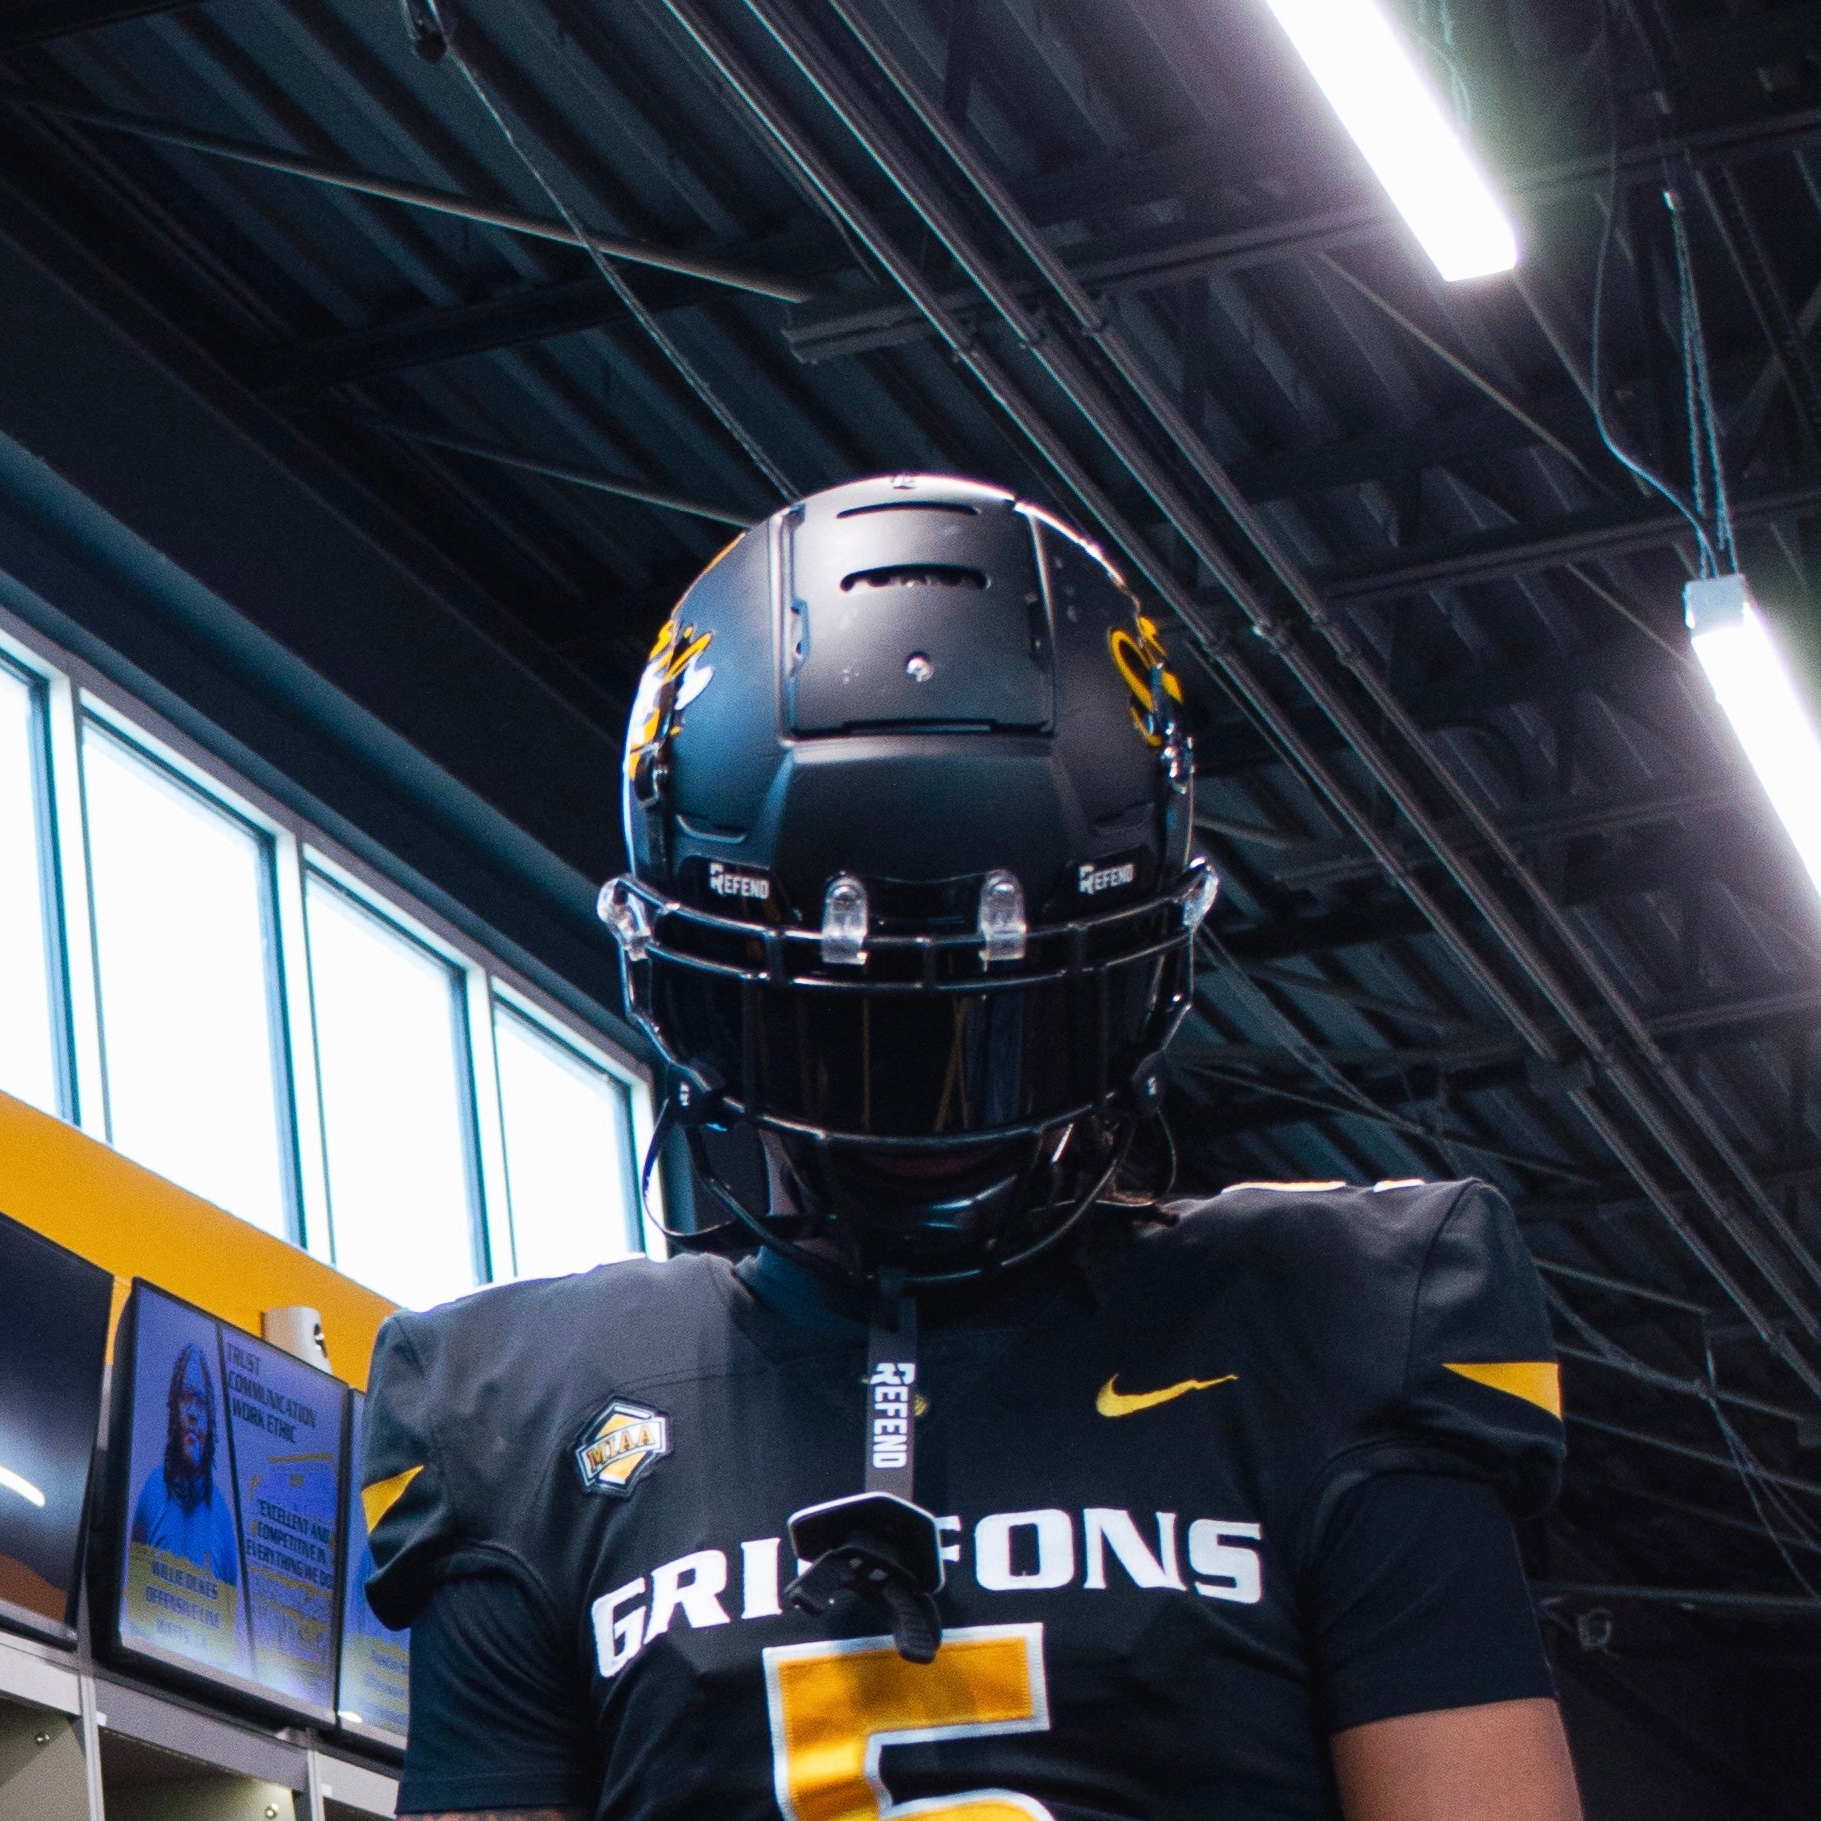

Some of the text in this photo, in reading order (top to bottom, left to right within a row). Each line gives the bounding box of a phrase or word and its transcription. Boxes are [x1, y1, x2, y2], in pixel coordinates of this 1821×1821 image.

[709, 862, 770, 899] REFEND
[586, 1425, 656, 1470] MIAA
[869, 1362, 916, 1469] REFEND
[591, 1508, 1263, 1678] GRIONS
